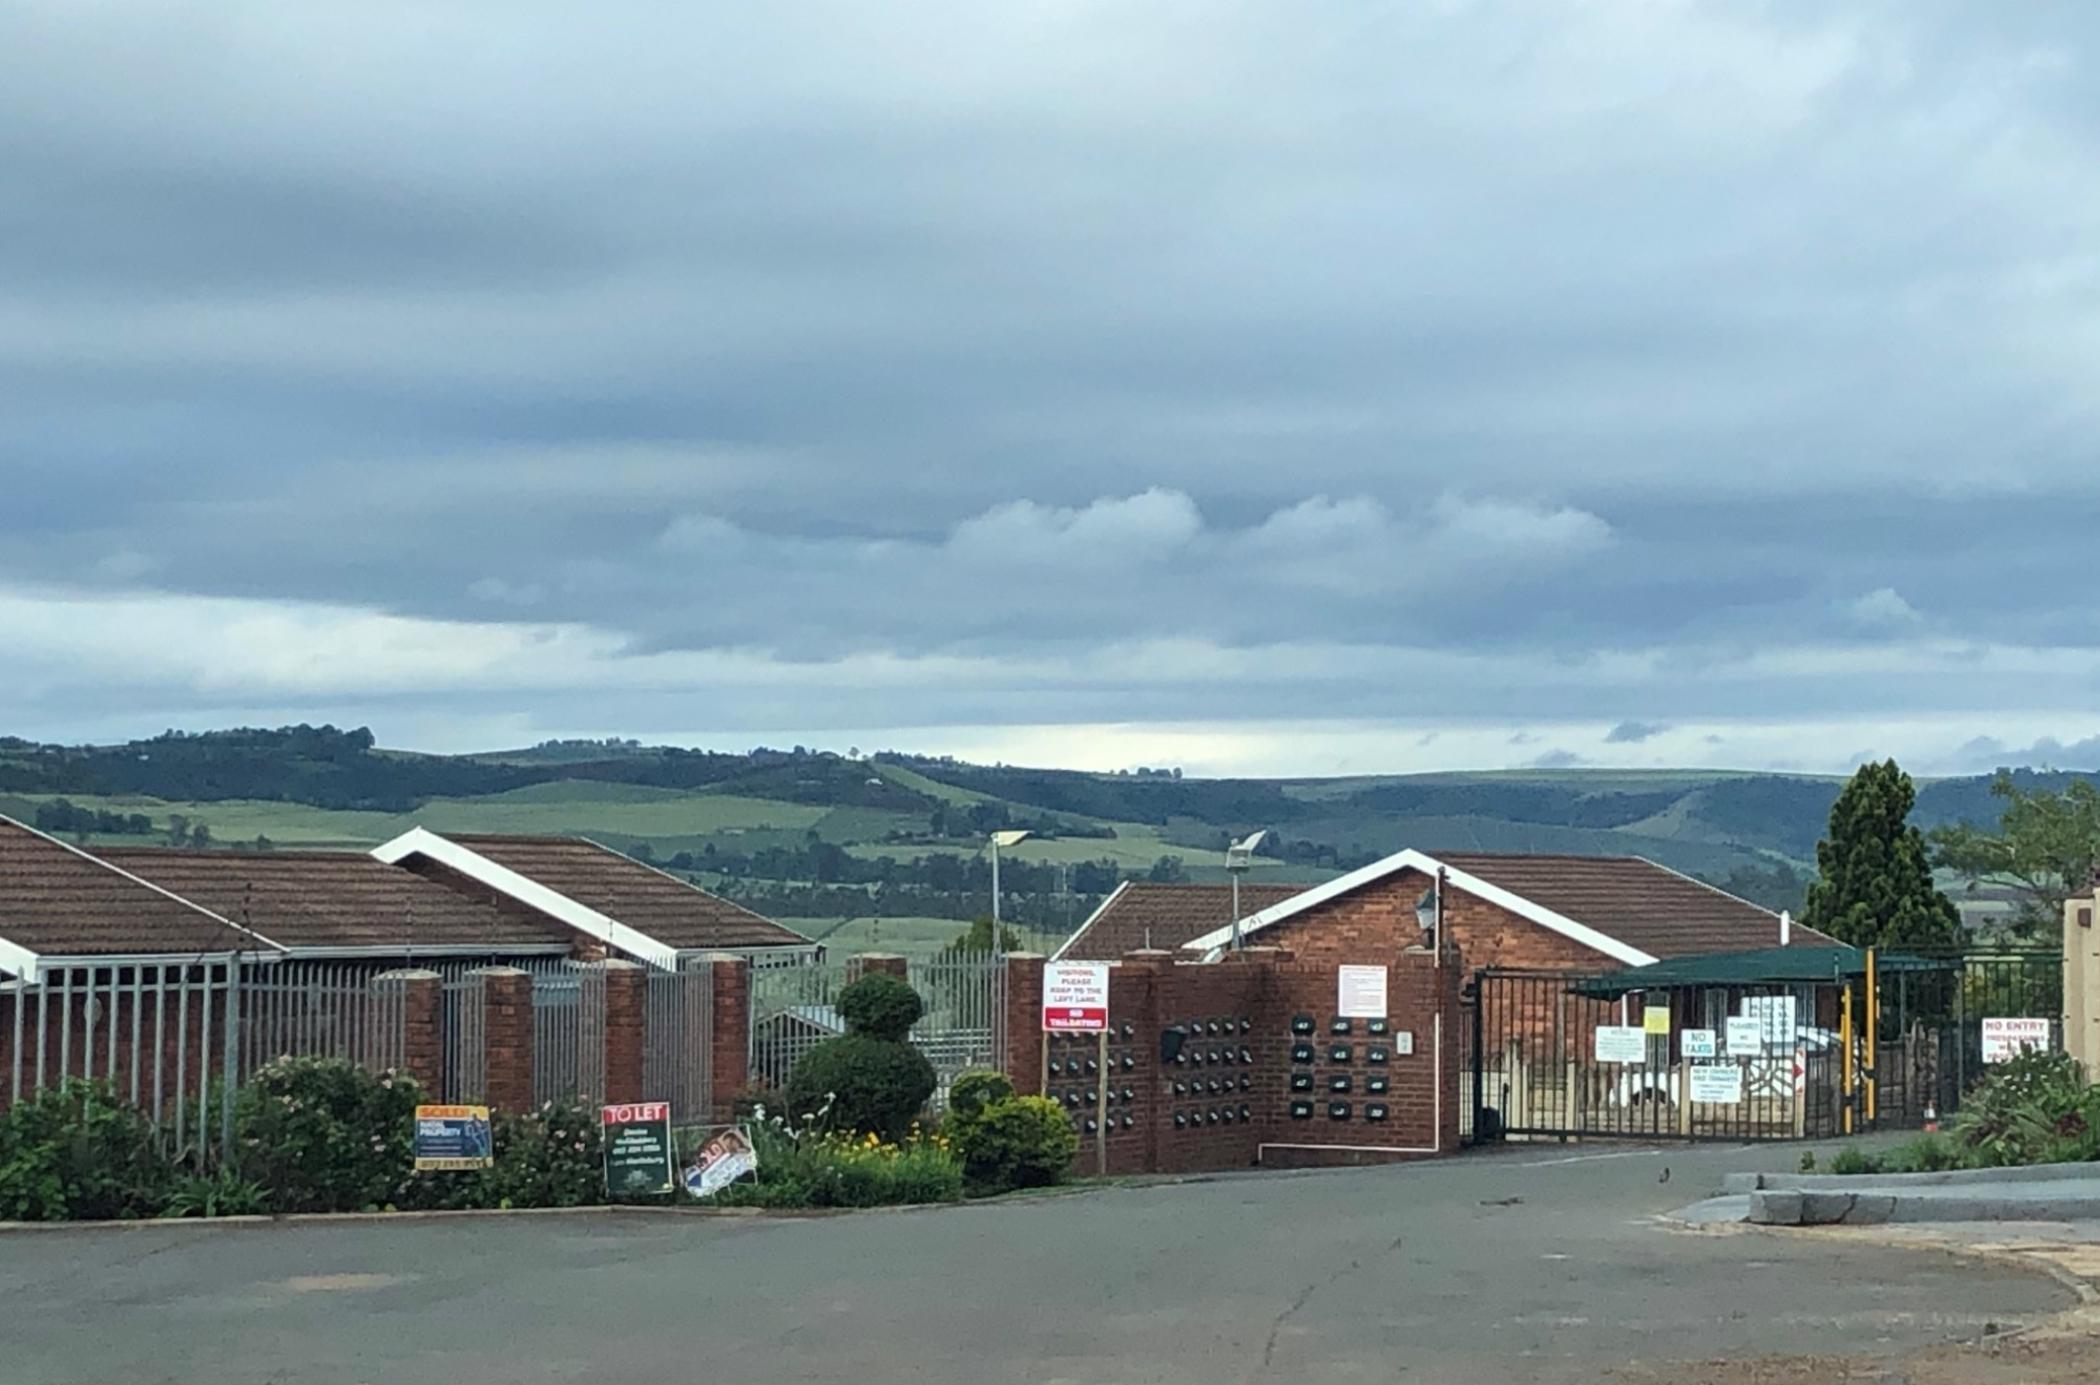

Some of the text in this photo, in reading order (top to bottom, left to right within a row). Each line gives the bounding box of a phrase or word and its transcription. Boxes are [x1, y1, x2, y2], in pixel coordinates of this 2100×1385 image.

[1985, 1020, 2044, 1030] NO ENTRY
[1691, 1032, 1706, 1041] NO
[1685, 1044, 1712, 1053] TAXIS
[608, 1105, 663, 1123] TO LET
